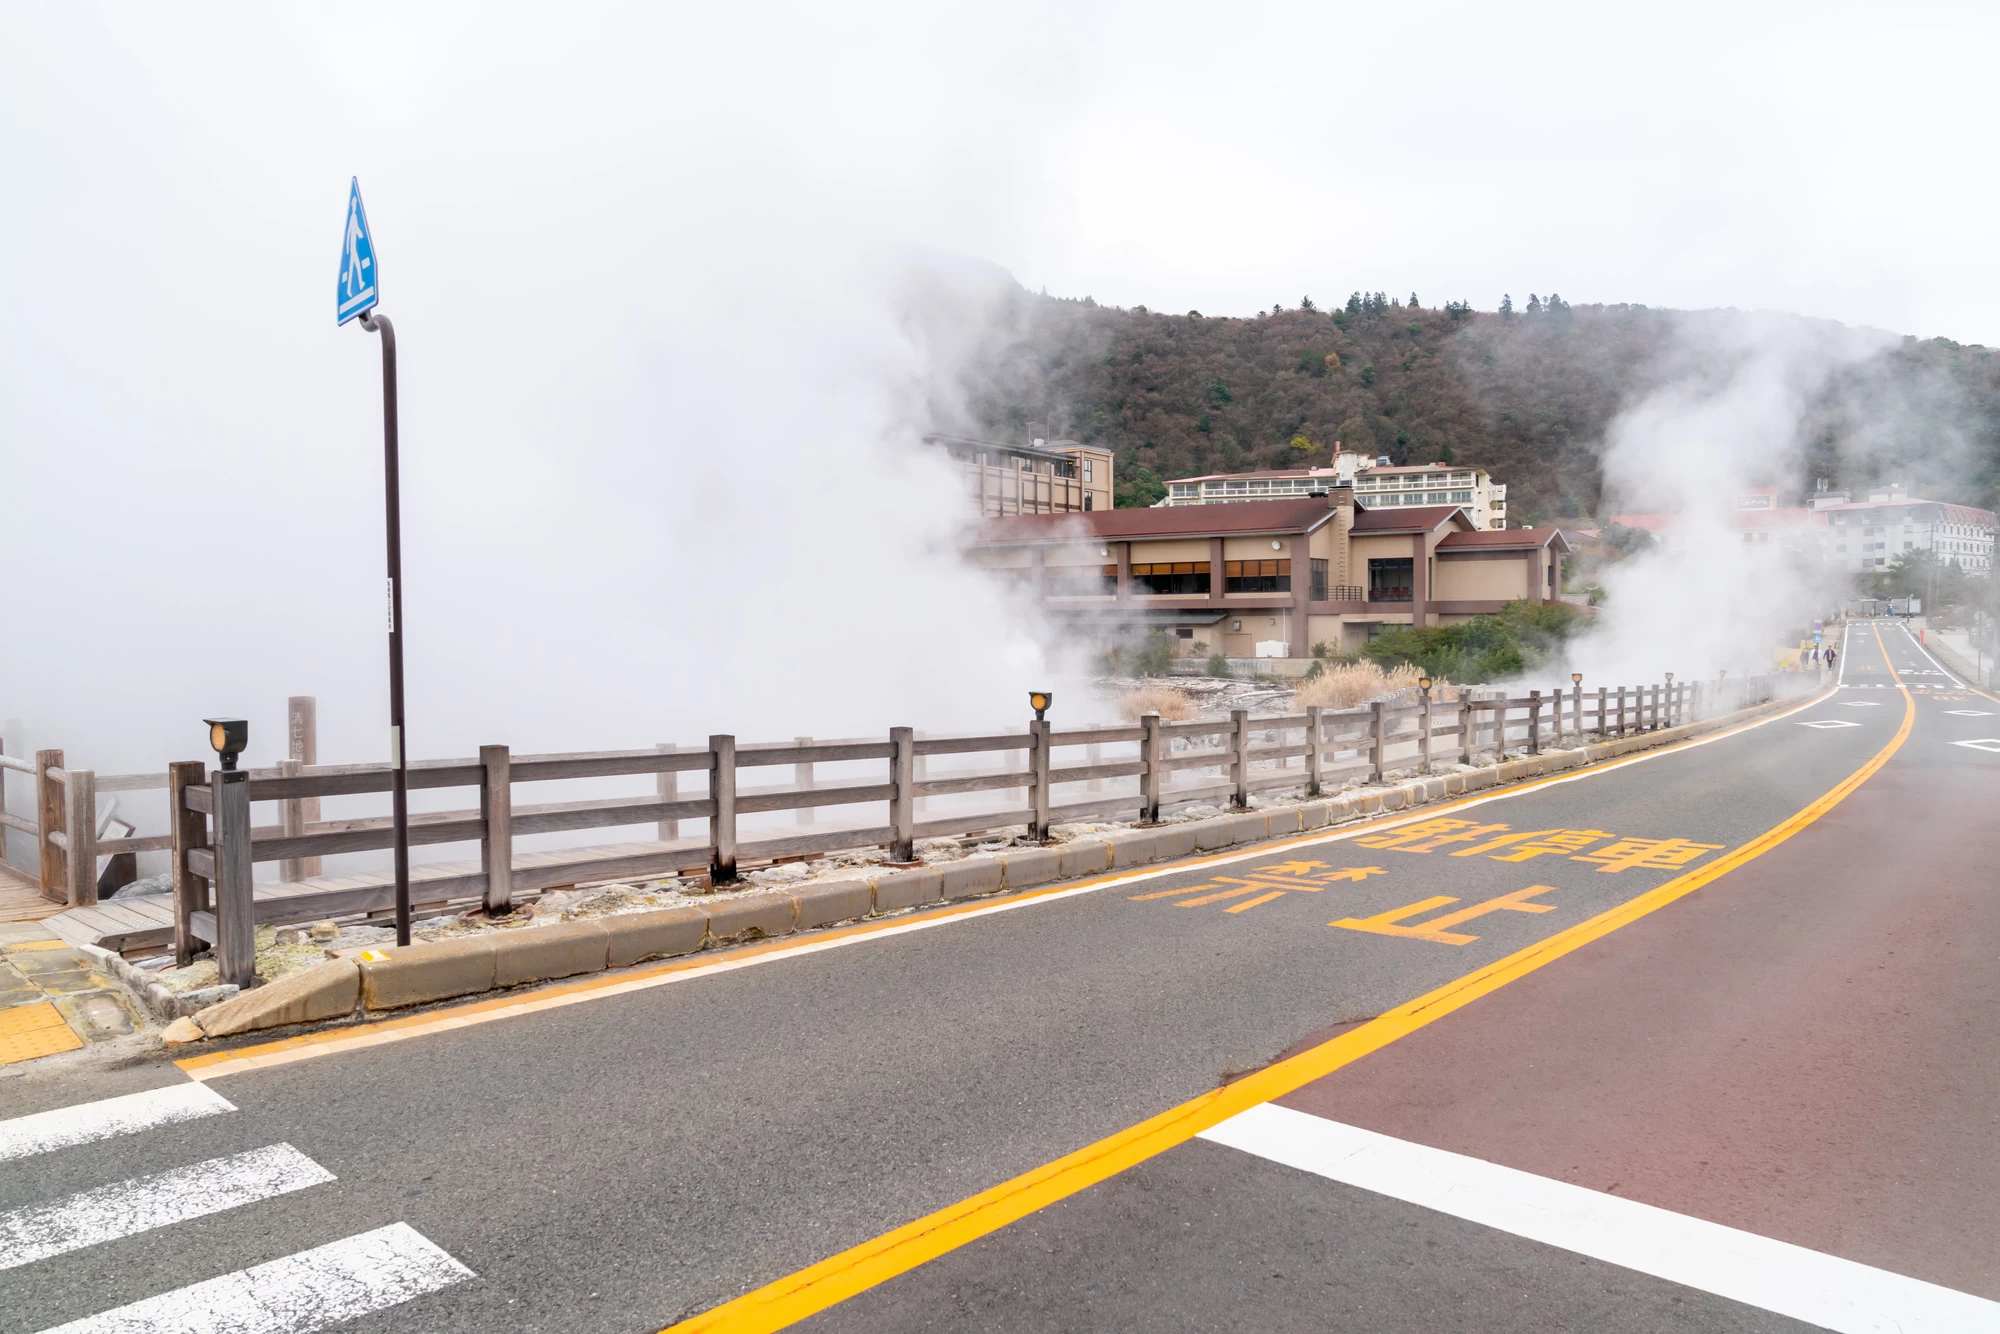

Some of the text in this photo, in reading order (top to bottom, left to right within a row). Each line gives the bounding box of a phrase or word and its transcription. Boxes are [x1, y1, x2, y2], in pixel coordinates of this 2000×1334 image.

[1353, 816, 1726, 873] 駐停車
[1127, 859, 1557, 947] 禁止
